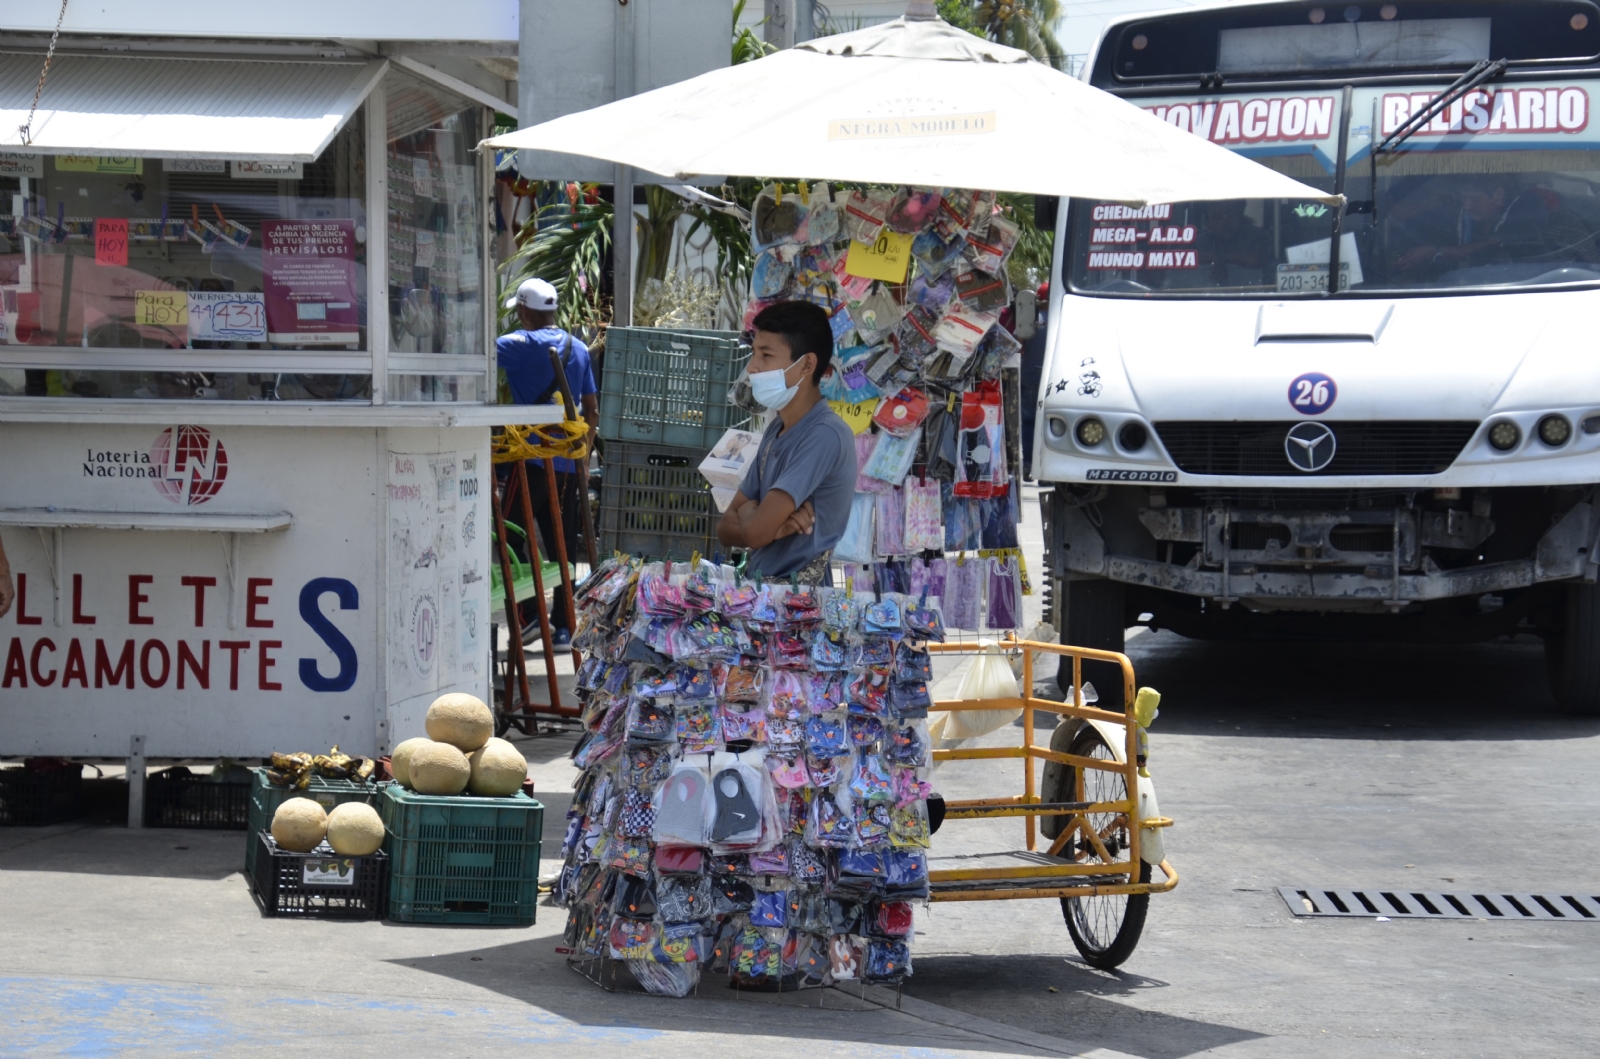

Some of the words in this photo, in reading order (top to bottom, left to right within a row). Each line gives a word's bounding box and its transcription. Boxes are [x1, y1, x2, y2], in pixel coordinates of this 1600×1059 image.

[877, 97, 944, 107] CERVEZA
[1383, 88, 1587, 135] BELISARIO
[839, 122, 901, 135] NEGRA
[910, 117, 985, 133] MODELO
[1093, 204, 1170, 220] CHEDRAUI
[100, 223, 126, 233] PARA
[1150, 227, 1194, 242] A.D.O
[98, 238, 125, 252] HOY
[269, 245, 348, 255] ¡REVÍSALOS!
[1089, 252, 1144, 267] MUNDO
[1148, 252, 1196, 267] MAYA
[135, 291, 174, 306] Para
[189, 293, 234, 301] VIERNES
[145, 304, 187, 323] HOY
[841, 360, 864, 377] KN95
[1295, 379, 1329, 406] 26
[88, 448, 150, 464] Loteria
[83, 463, 162, 478] Nacional
[459, 477, 479, 498] TODO
